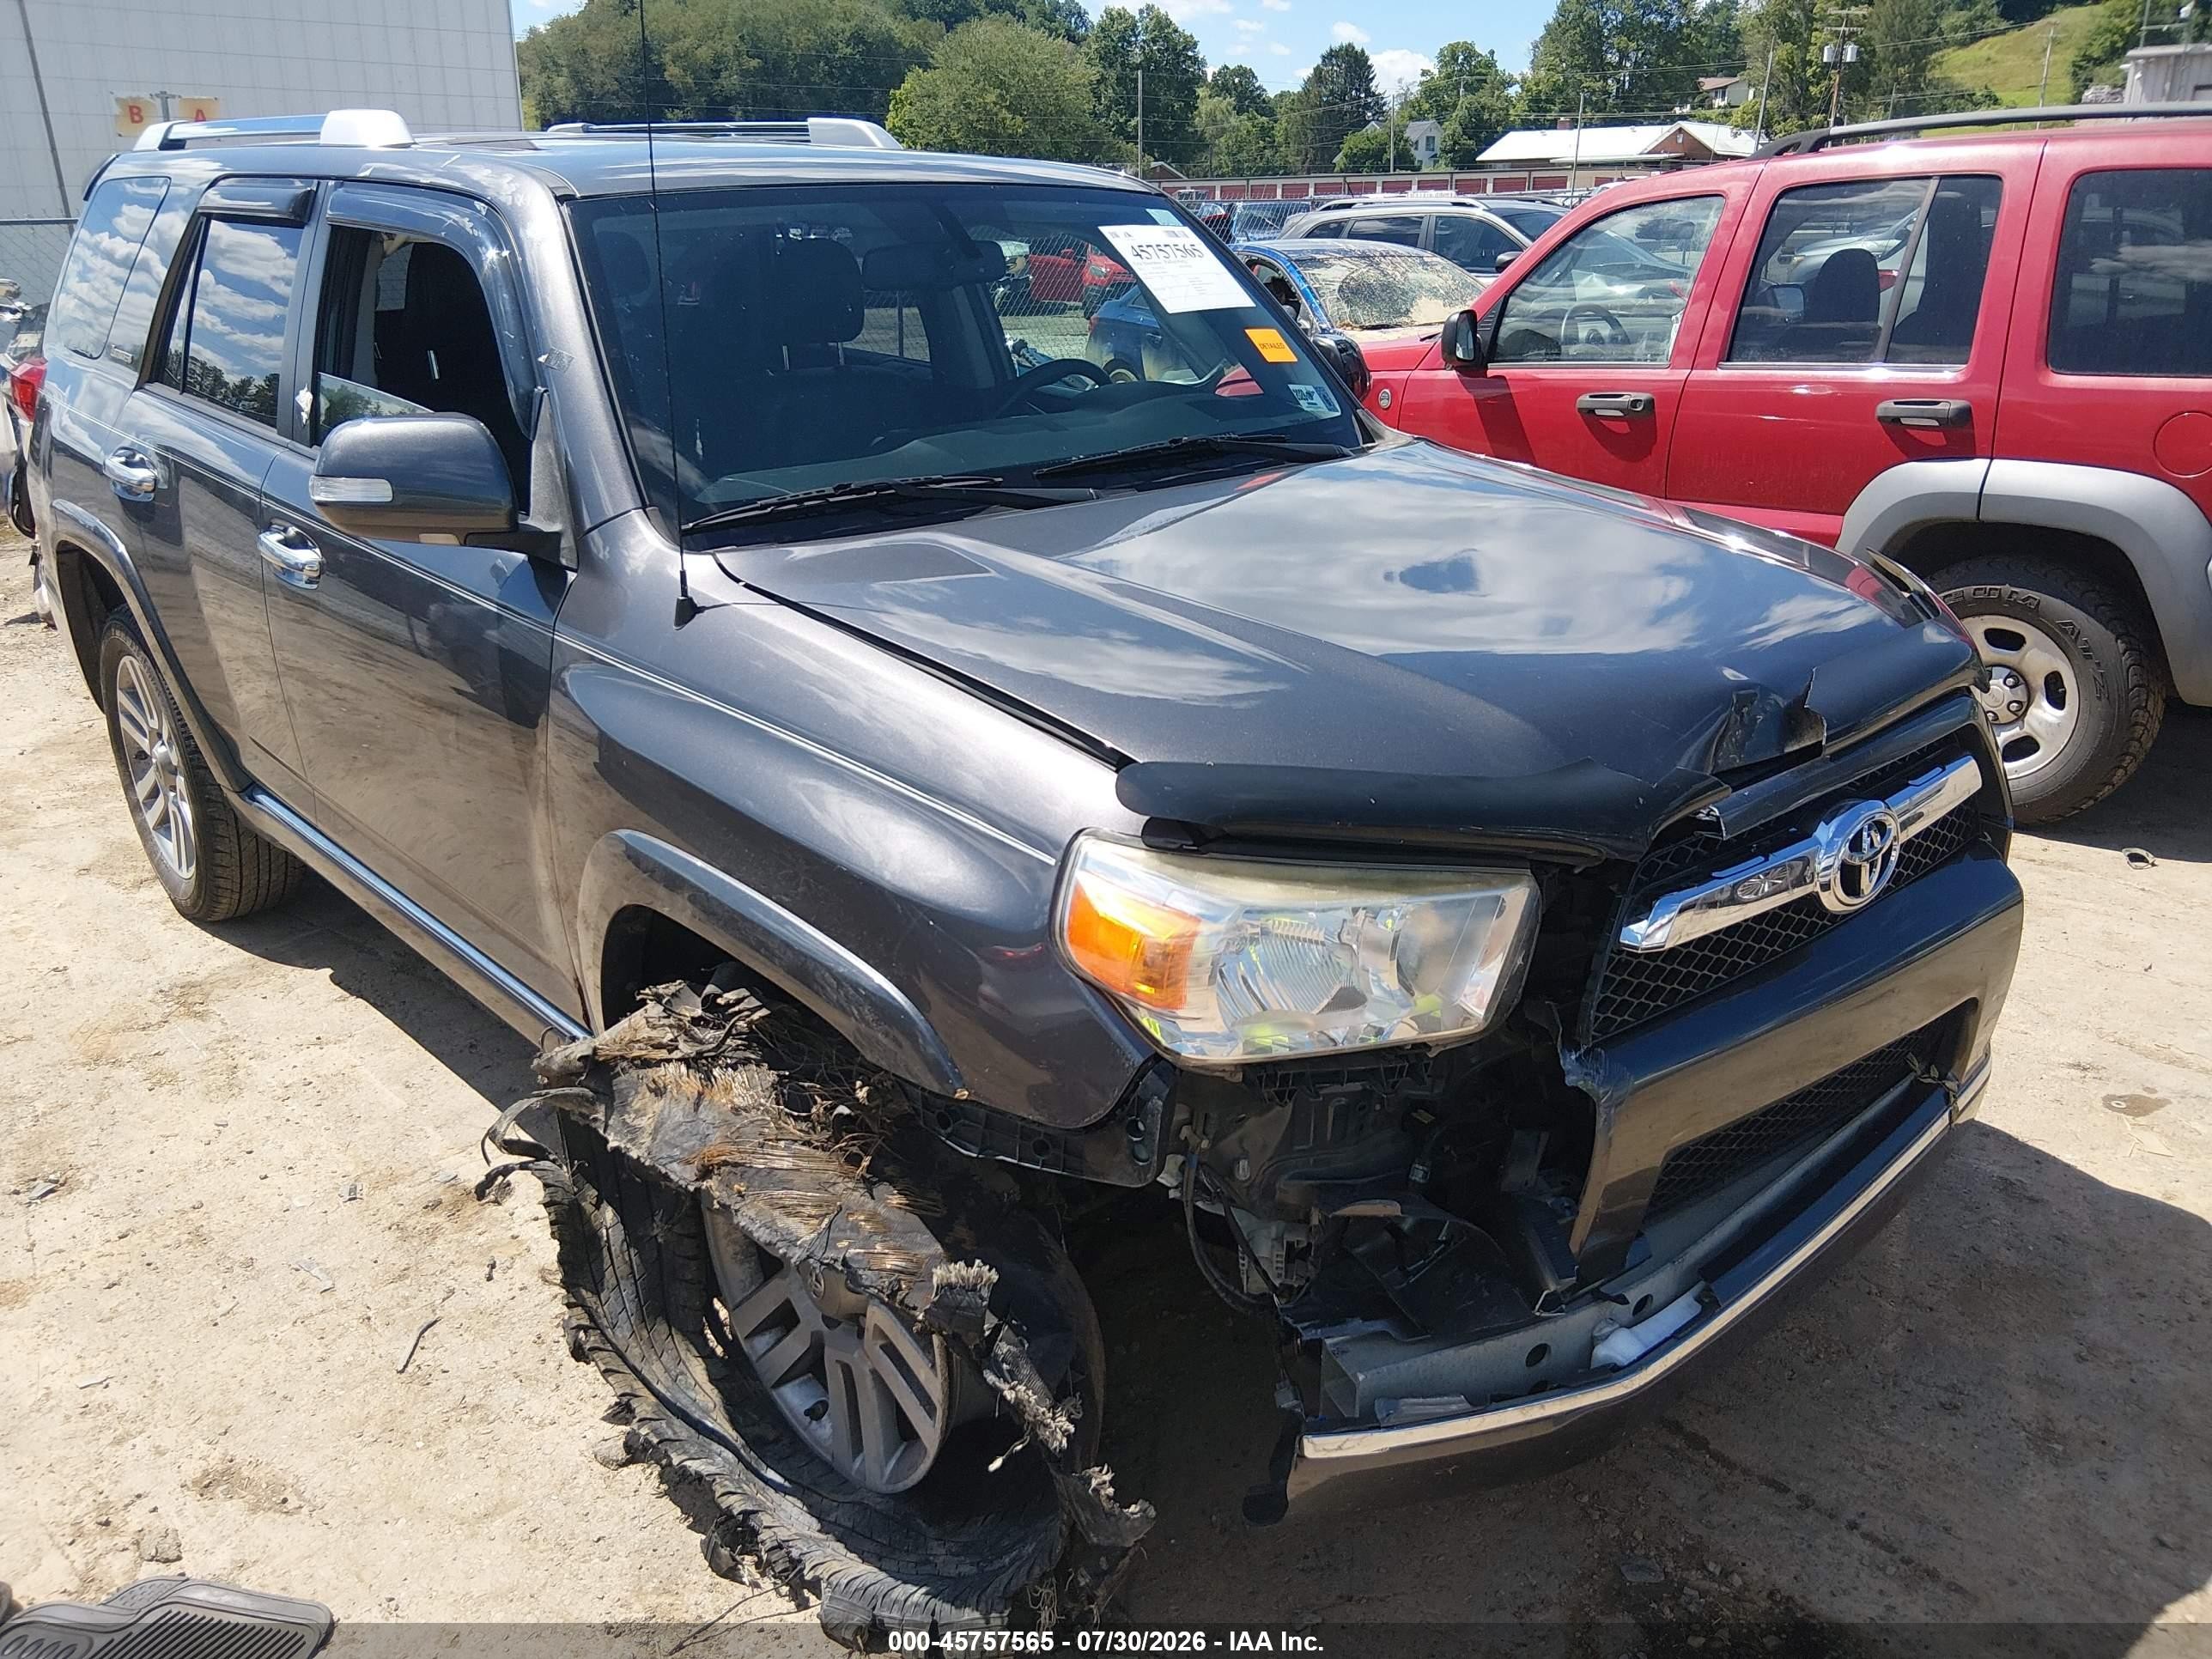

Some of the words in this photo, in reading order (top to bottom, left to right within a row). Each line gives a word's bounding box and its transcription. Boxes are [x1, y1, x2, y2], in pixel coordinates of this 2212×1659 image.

[128, 105, 144, 124] B
[194, 108, 207, 122] A
[1130, 244, 1205, 260] 45757565
